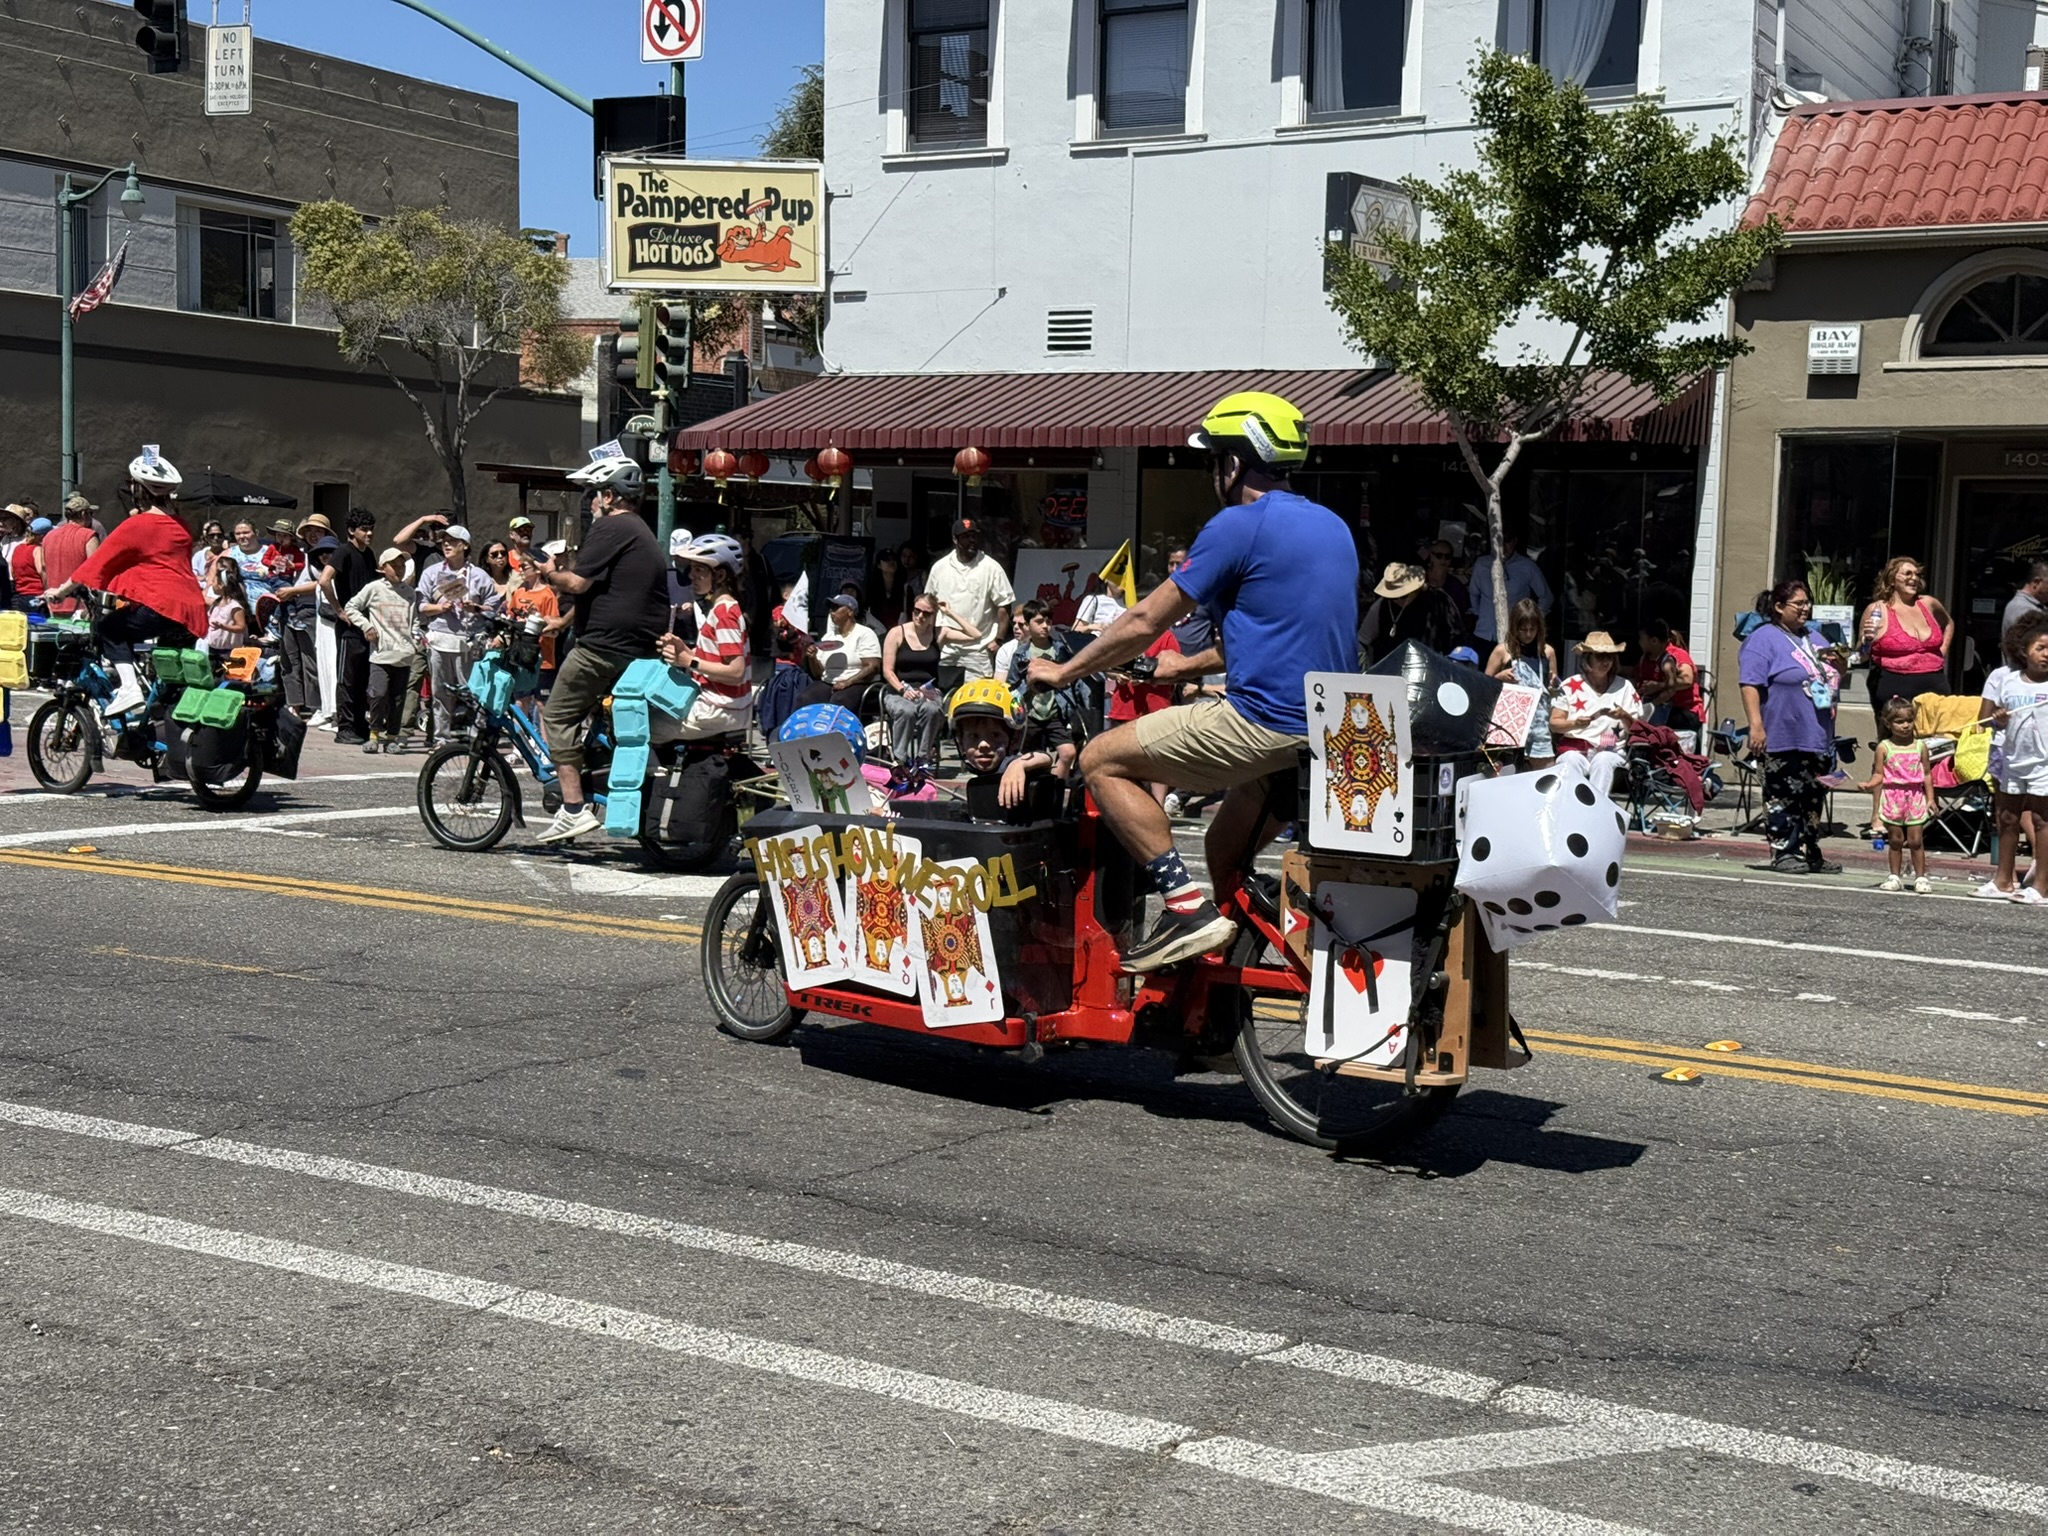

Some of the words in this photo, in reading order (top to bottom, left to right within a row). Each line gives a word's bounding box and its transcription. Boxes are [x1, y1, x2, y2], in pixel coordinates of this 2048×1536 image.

[223, 32, 236, 44] NO
[215, 48, 243, 60] LEFT
[214, 65, 244, 77] TURN
[638, 172, 669, 193] The
[617, 183, 750, 223] Pampered
[764, 187, 814, 226] Pup
[649, 227, 704, 244] Deluxe
[635, 238, 668, 264] HOT
[671, 238, 715, 266] DOGS
[1817, 330, 1853, 341] BAY
[1043, 497, 1088, 517] OPE
[1313, 683, 1326, 699] Q
[778, 752, 803, 804] JOKER
[1392, 826, 1404, 843] Q
[1323, 893, 1333, 906] A
[800, 993, 873, 1017] TREK
[1388, 1042, 1398, 1054] A
